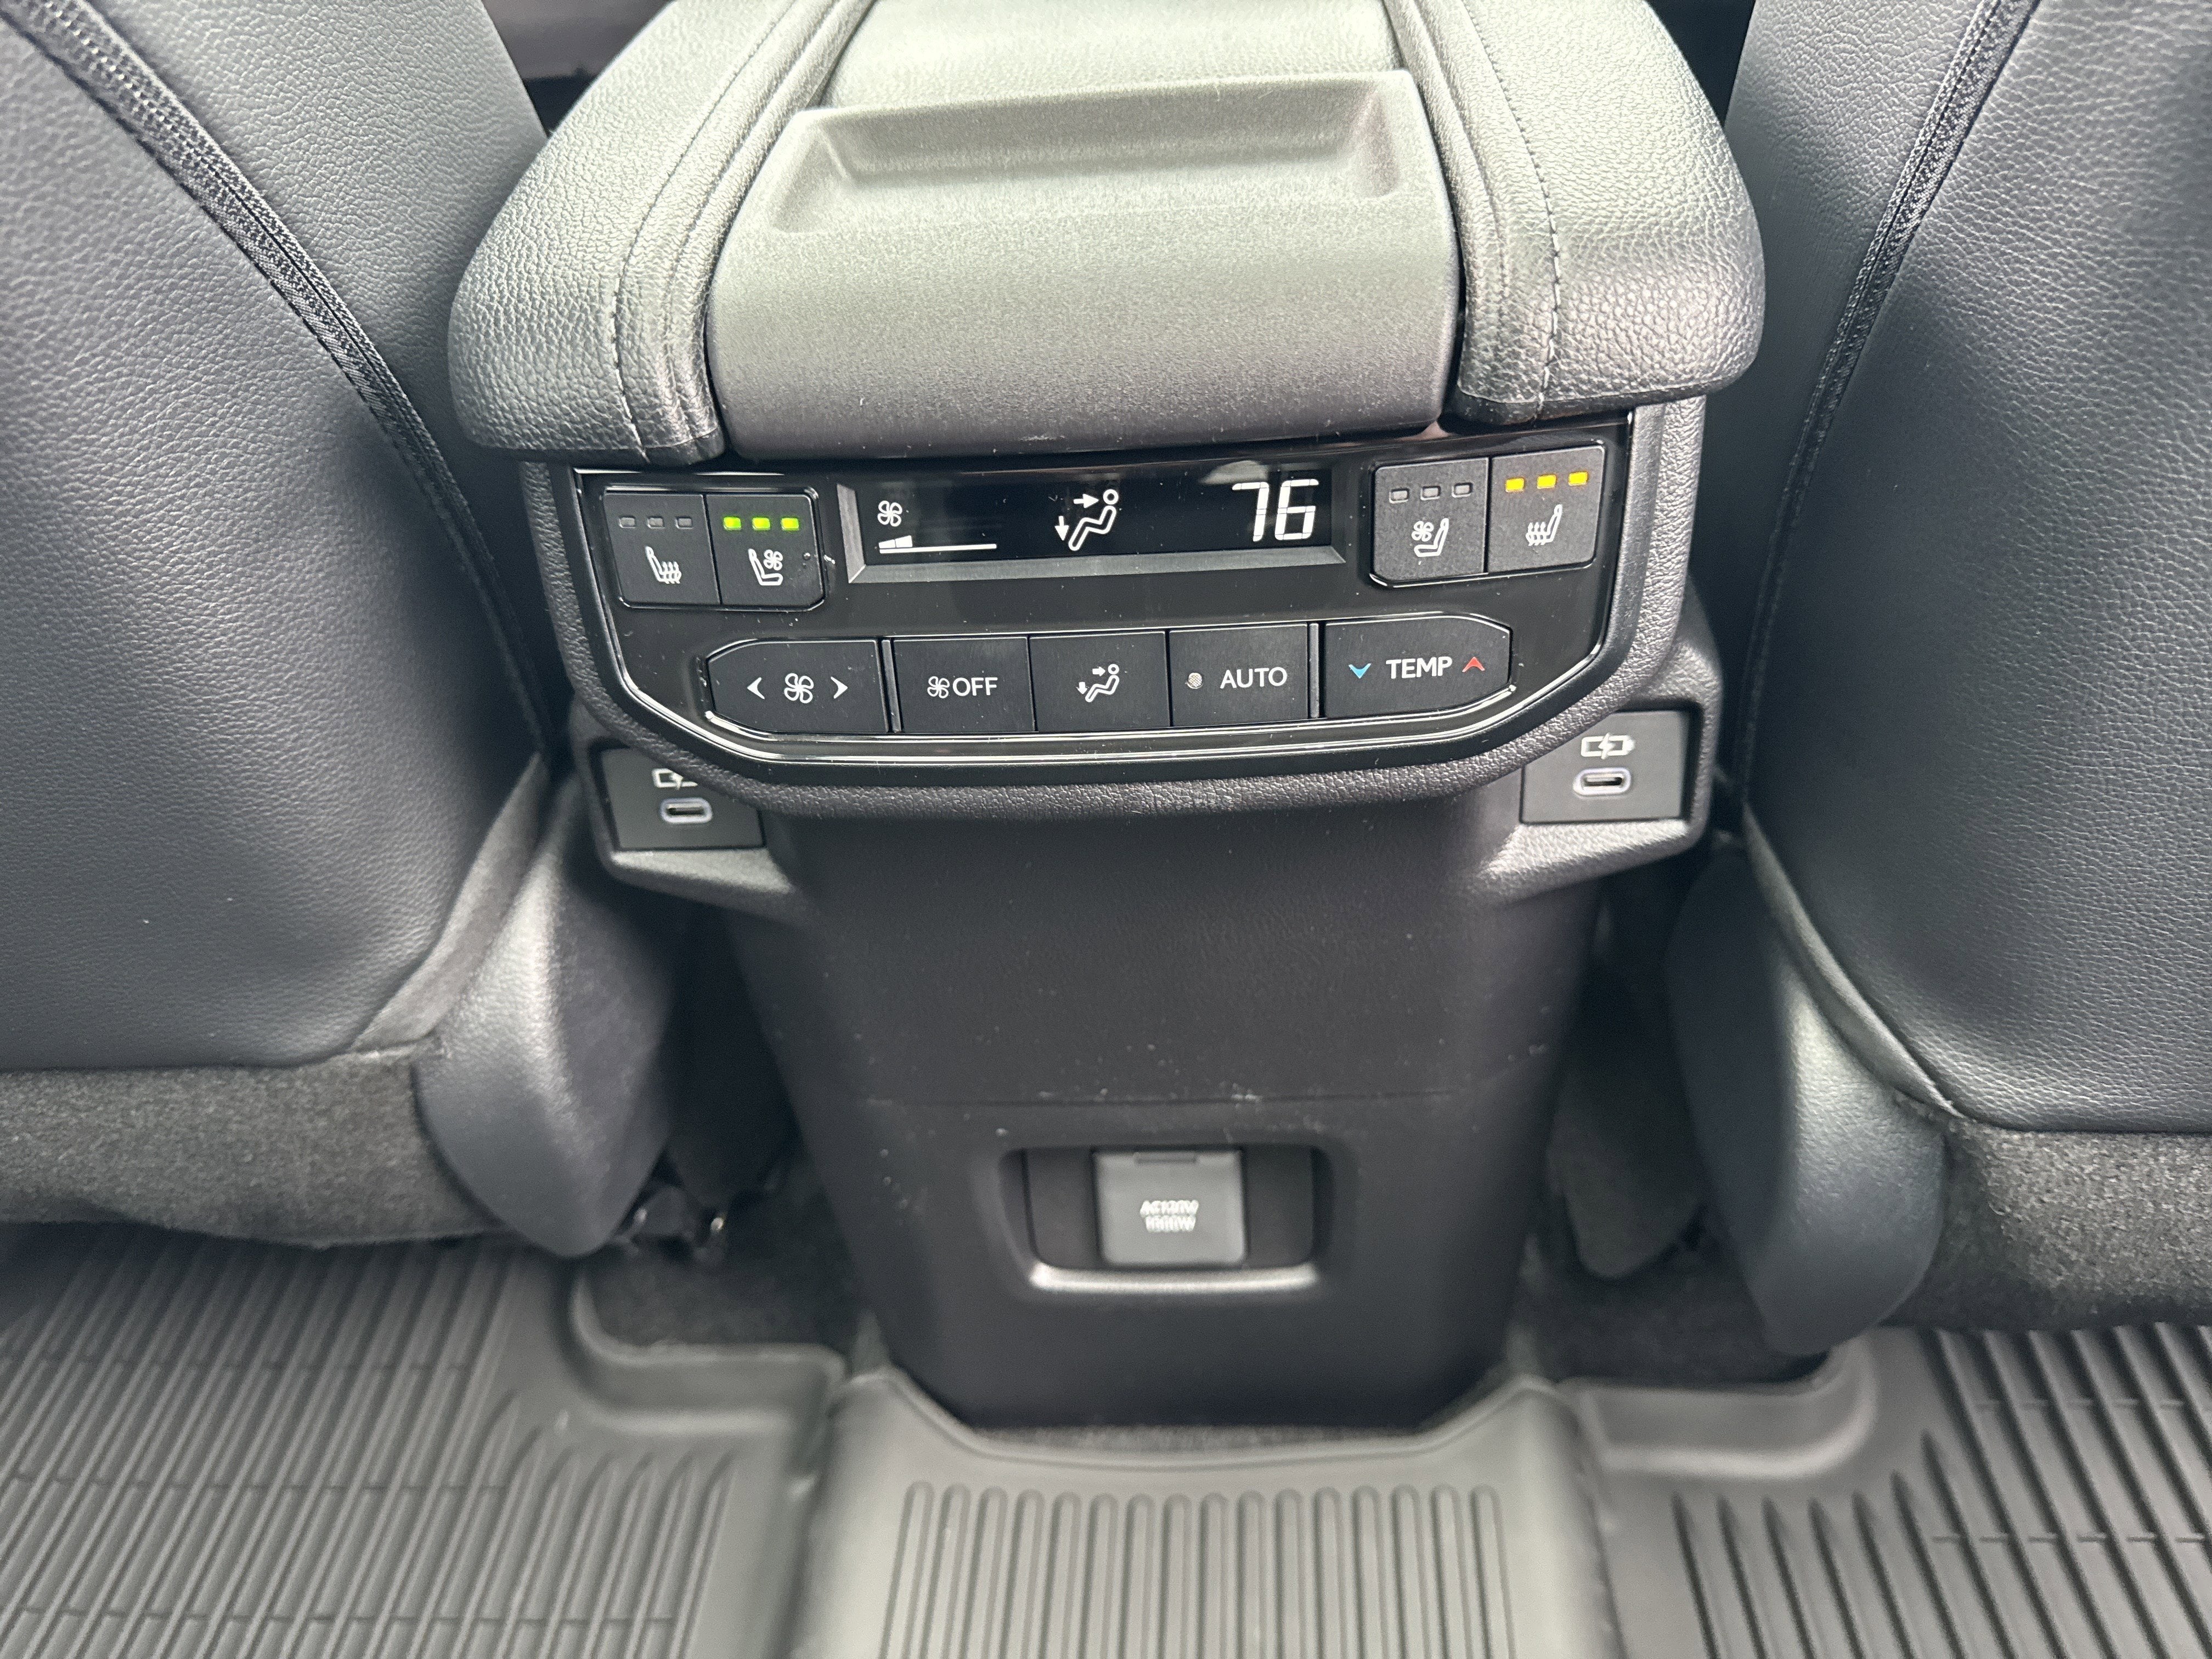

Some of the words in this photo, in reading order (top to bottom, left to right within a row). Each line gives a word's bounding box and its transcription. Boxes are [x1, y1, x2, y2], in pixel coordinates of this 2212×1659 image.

[1232, 478, 1319, 541] 76
[1220, 665, 1289, 690] AUTO
[1385, 655, 1453, 680] TEMP
[952, 676, 998, 697] OFF
